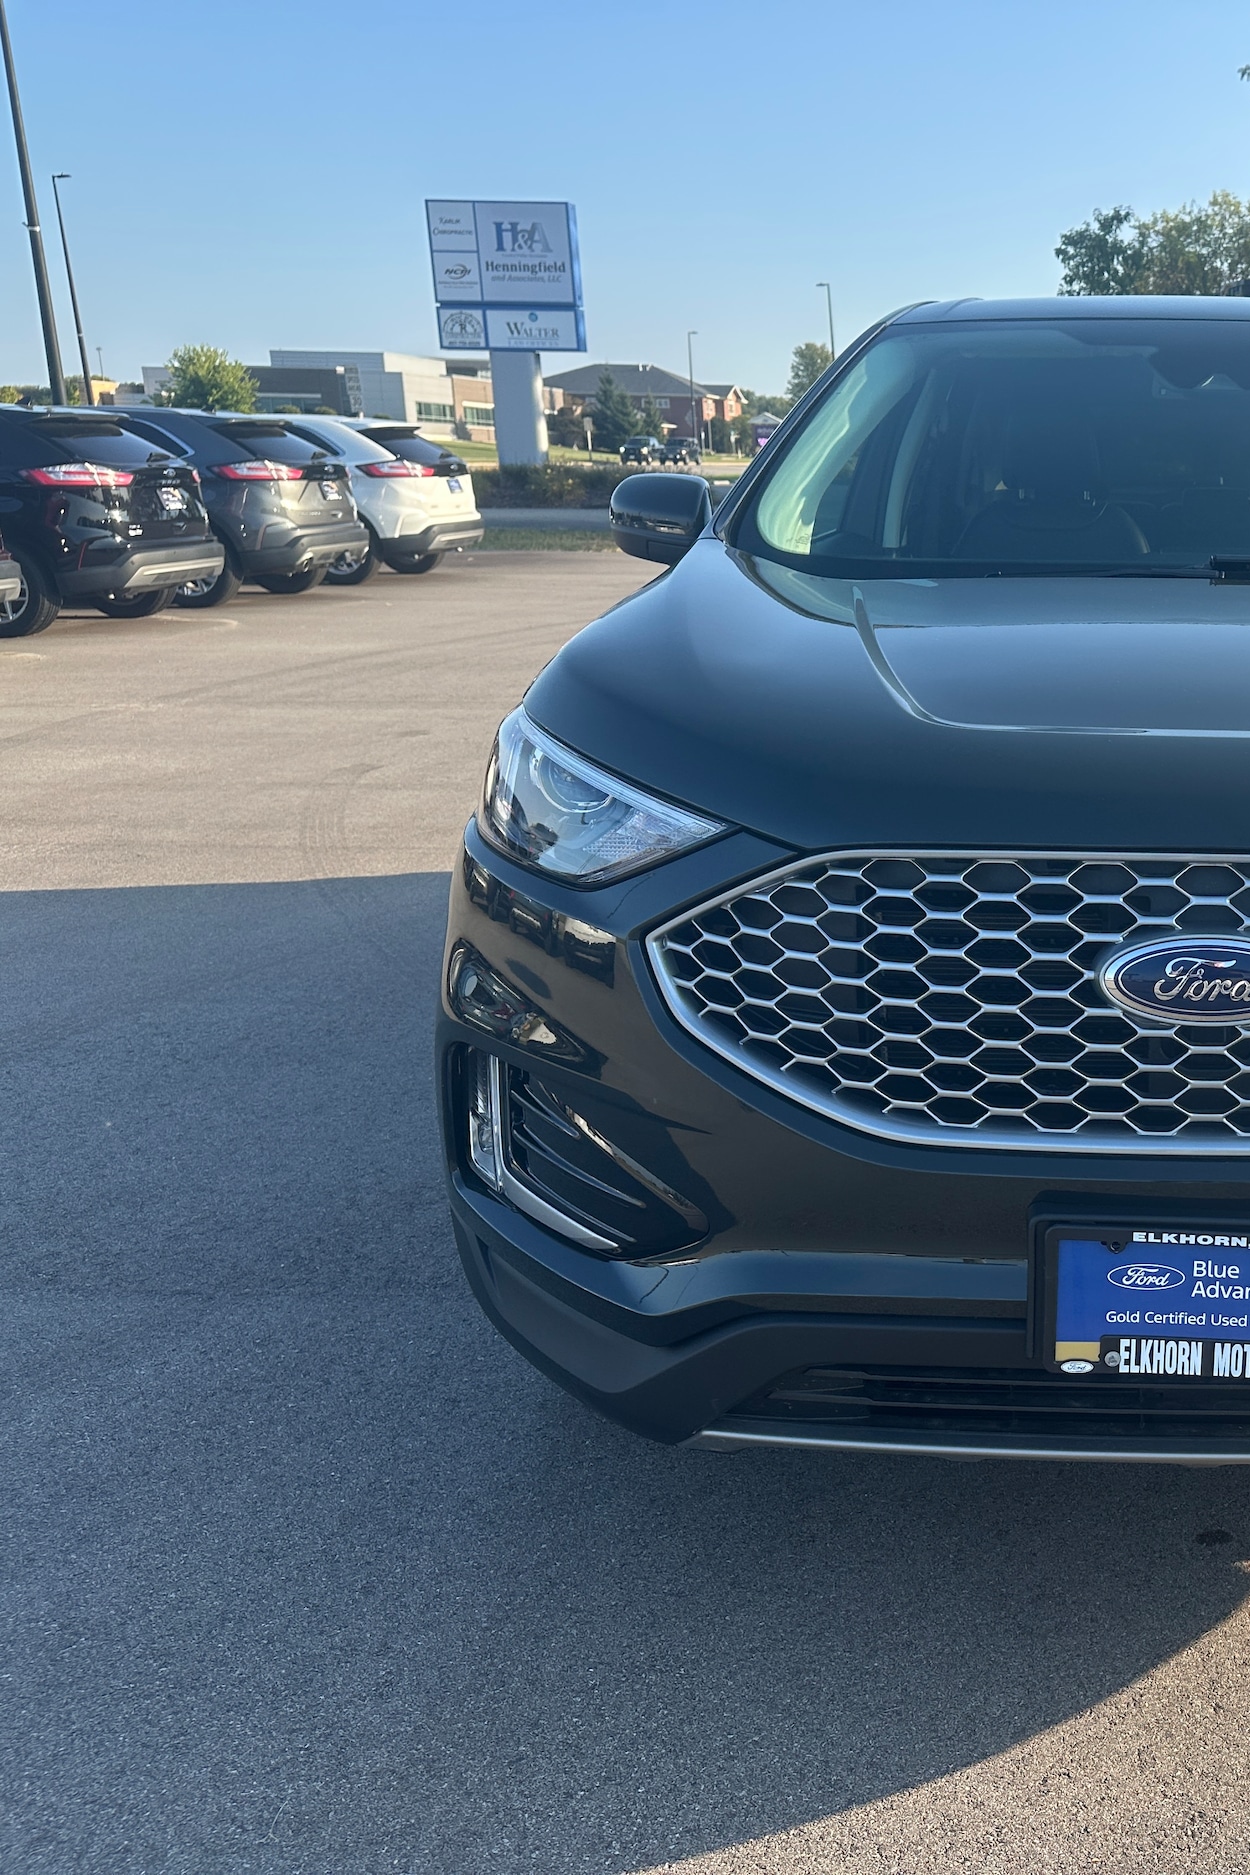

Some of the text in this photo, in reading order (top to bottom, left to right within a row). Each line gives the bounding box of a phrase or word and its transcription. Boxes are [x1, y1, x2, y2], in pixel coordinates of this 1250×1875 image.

[493, 221, 553, 253] H&A
[485, 260, 566, 276] Henningfield
[491, 274, 563, 283] and Associates, LLC
[1122, 1265, 1170, 1289] Ford
[1192, 1260, 1240, 1279] Blue
[1105, 1310, 1140, 1324] Gold
[1144, 1311, 1206, 1326] Certified
[1210, 1313, 1248, 1328] Used
[1119, 1338, 1203, 1376] ELKHORN
